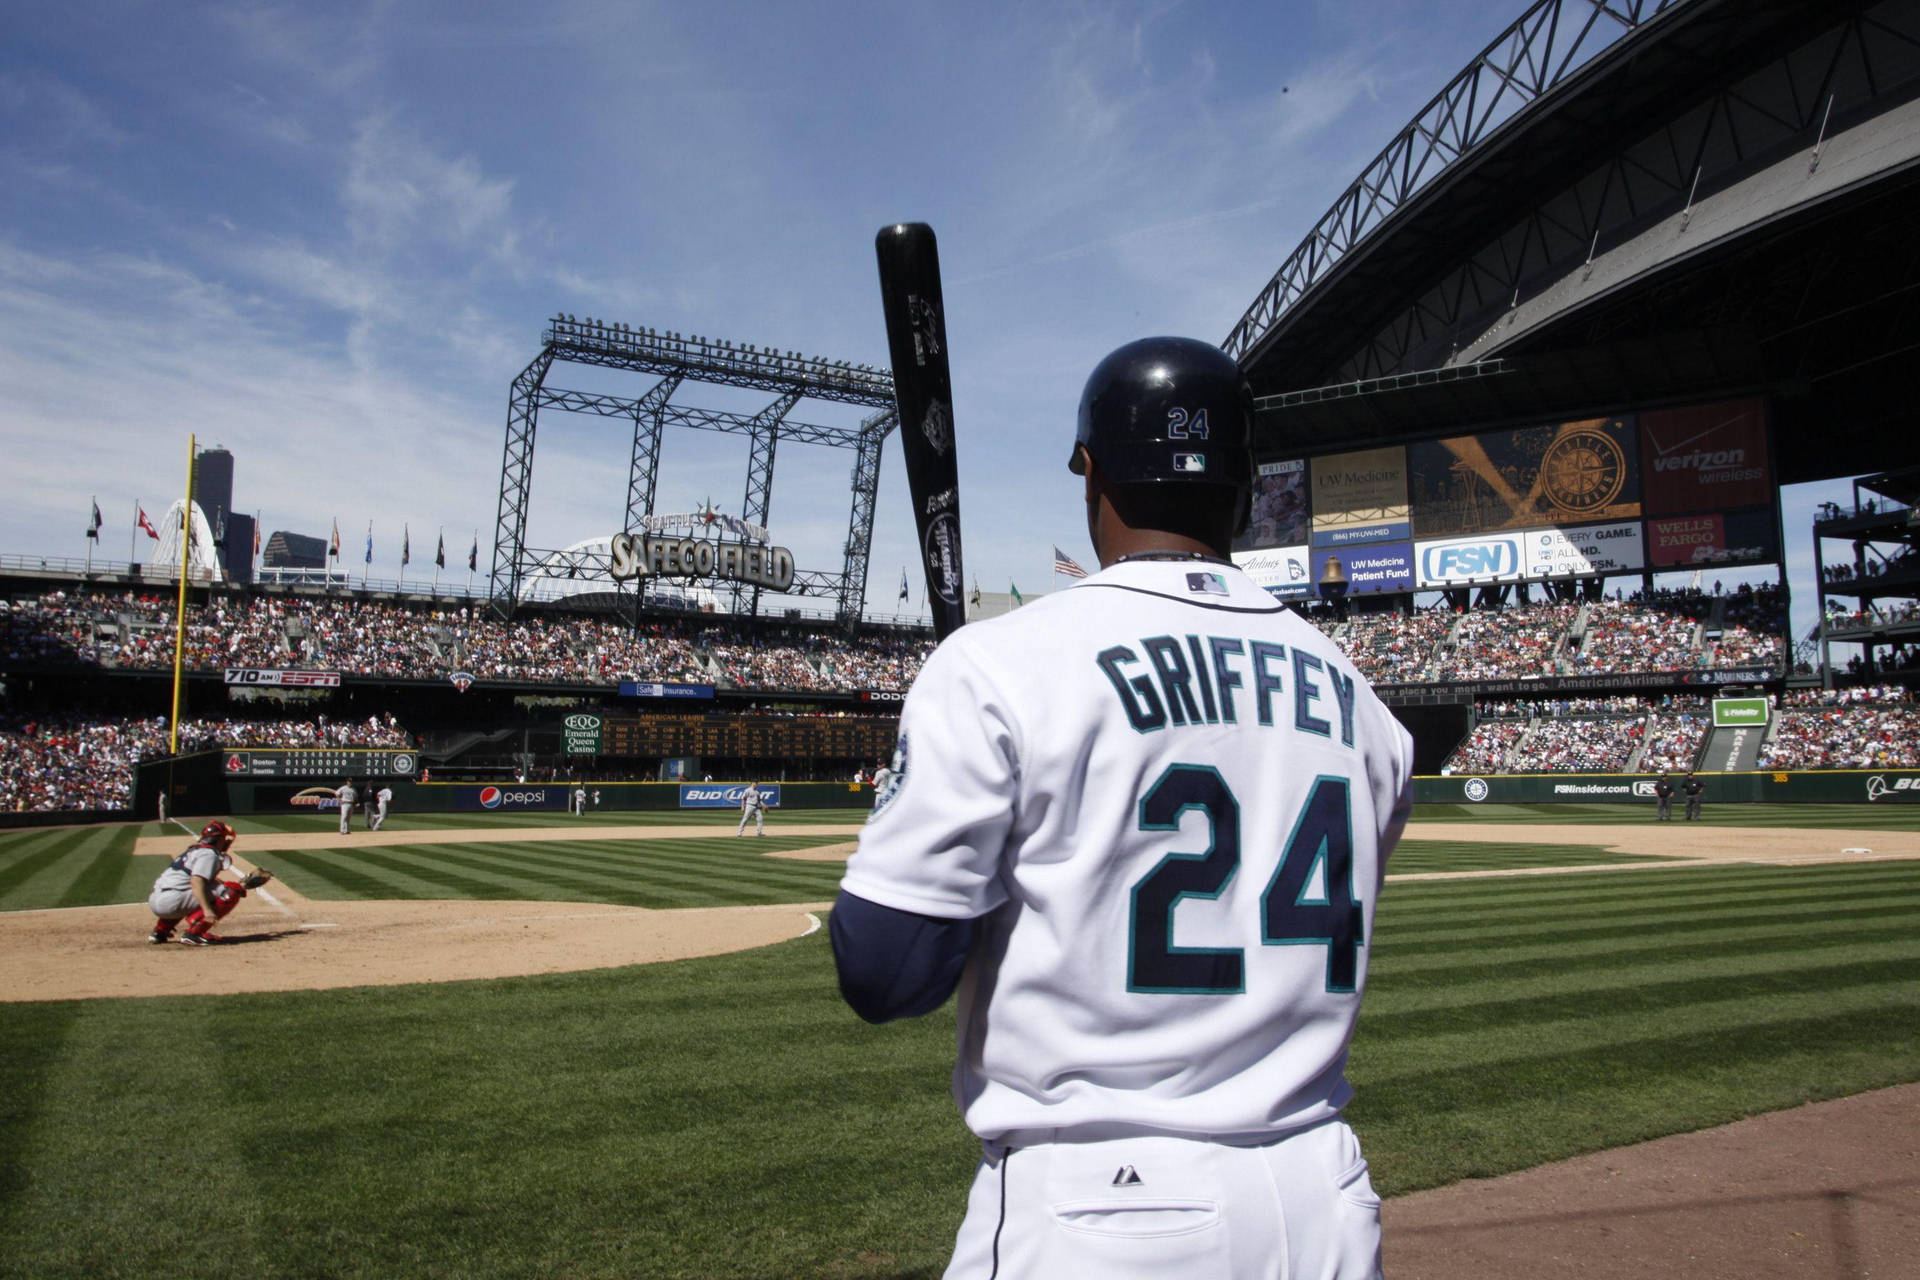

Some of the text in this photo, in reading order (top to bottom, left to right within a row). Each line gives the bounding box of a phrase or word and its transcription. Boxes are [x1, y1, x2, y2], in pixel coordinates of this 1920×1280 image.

[1167, 407, 1209, 440] 24
[1653, 448, 1744, 472] verizon
[1319, 469, 1399, 486] UW Medicine
[1700, 468, 1762, 484] wireless
[1656, 518, 1713, 534] WELLS
[1557, 527, 1636, 544] EVERY GAME.
[1660, 533, 1714, 547] FARGO
[1558, 548, 1577, 559] ALL
[1581, 545, 1601, 556] HD.
[611, 532, 795, 592] SAFECO FIELD
[1351, 557, 1405, 570] UW Medicine
[1437, 544, 1503, 577] FSN
[1558, 559, 1617, 572] ONLY FSN.
[1352, 568, 1409, 581] Patient Fund
[226, 670, 259, 682] 710
[280, 672, 339, 685] ESPN
[1557, 674, 1675, 689] American Airlines
[1096, 634, 1355, 749] GRIFFEY
[1400, 688, 1427, 697] place
[1431, 687, 1448, 696] you
[1455, 685, 1480, 694] most
[1487, 683, 1514, 692] want
[1519, 682, 1530, 690] to
[565, 730, 599, 738] Emerald
[567, 745, 595, 753] Casino
[568, 738, 595, 747] Queen
[1554, 784, 1630, 794] FSNinsider.com
[1639, 783, 1656, 794] FS
[503, 790, 545, 805] pepsi
[1126, 762, 1365, 994] 24
